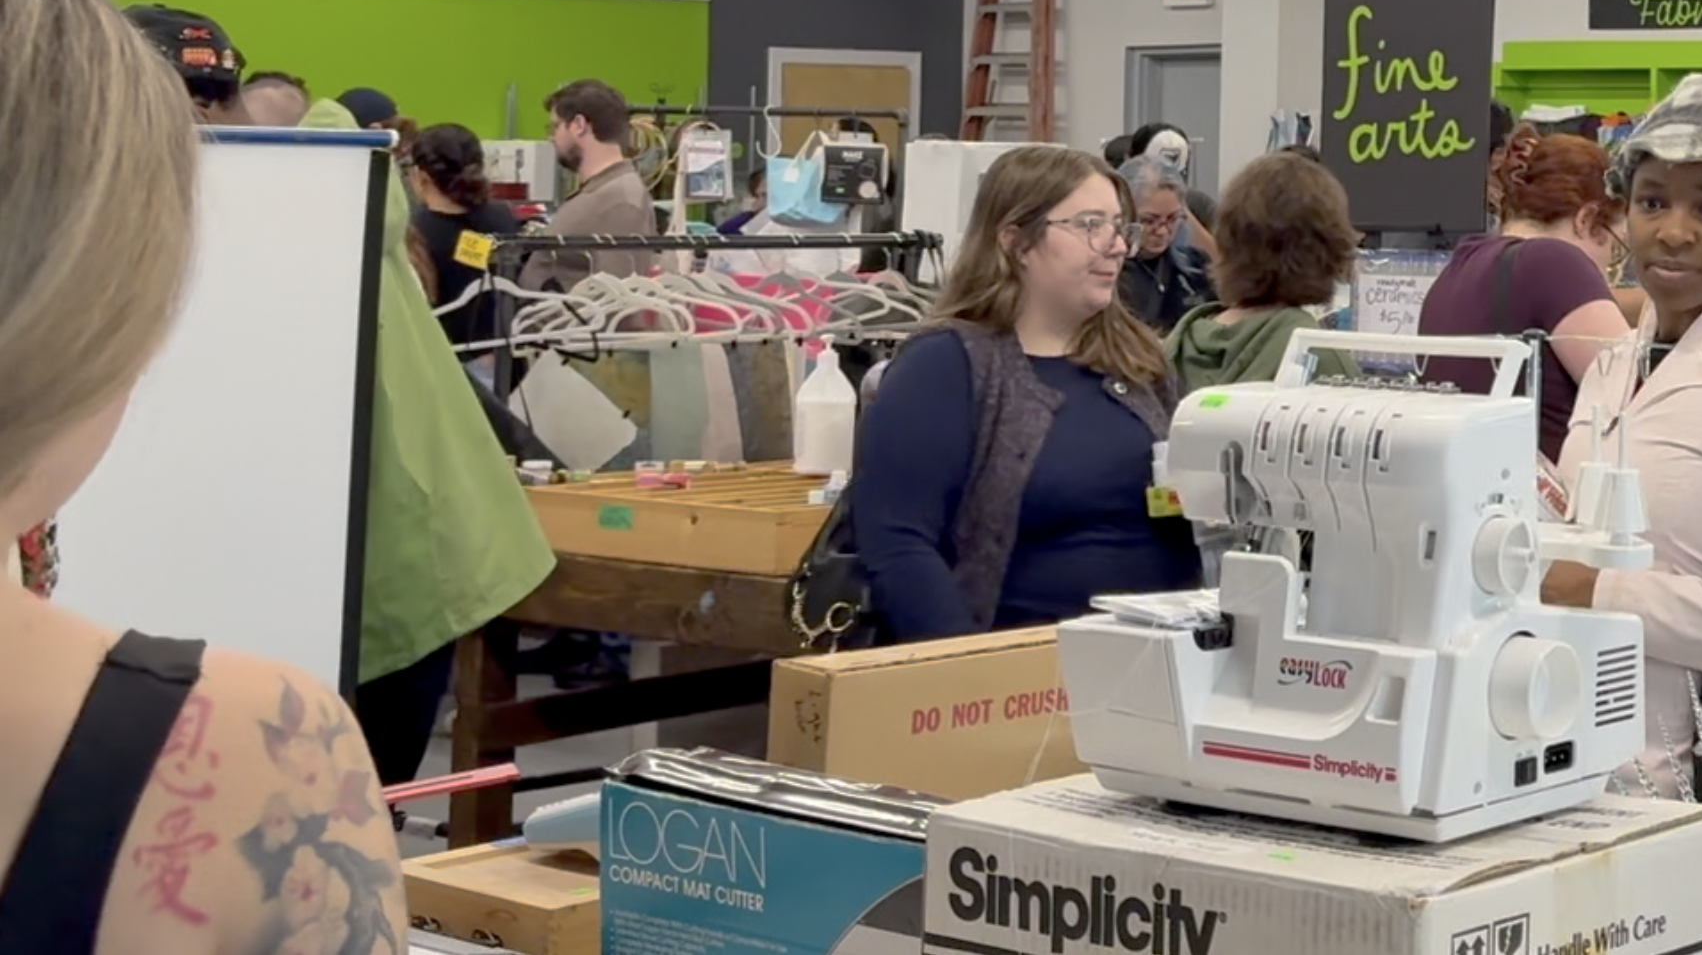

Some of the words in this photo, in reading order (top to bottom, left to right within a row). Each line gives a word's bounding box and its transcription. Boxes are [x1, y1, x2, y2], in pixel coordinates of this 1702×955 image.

[1333, 5, 1458, 120] fine
[1348, 98, 1476, 164] arts
[911, 707, 941, 735] DO
[952, 699, 993, 729] NOT
[1003, 687, 1069, 720] CRUSH
[1313, 753, 1384, 784] Simplicity
[608, 796, 766, 890] LOGAN
[609, 864, 680, 894] COMPACT
[683, 878, 711, 901] MAT
[714, 886, 764, 913] CUTTER
[948, 846, 1218, 955] Simplicity
[1593, 918, 1630, 953] With
[1632, 914, 1666, 942] Care
